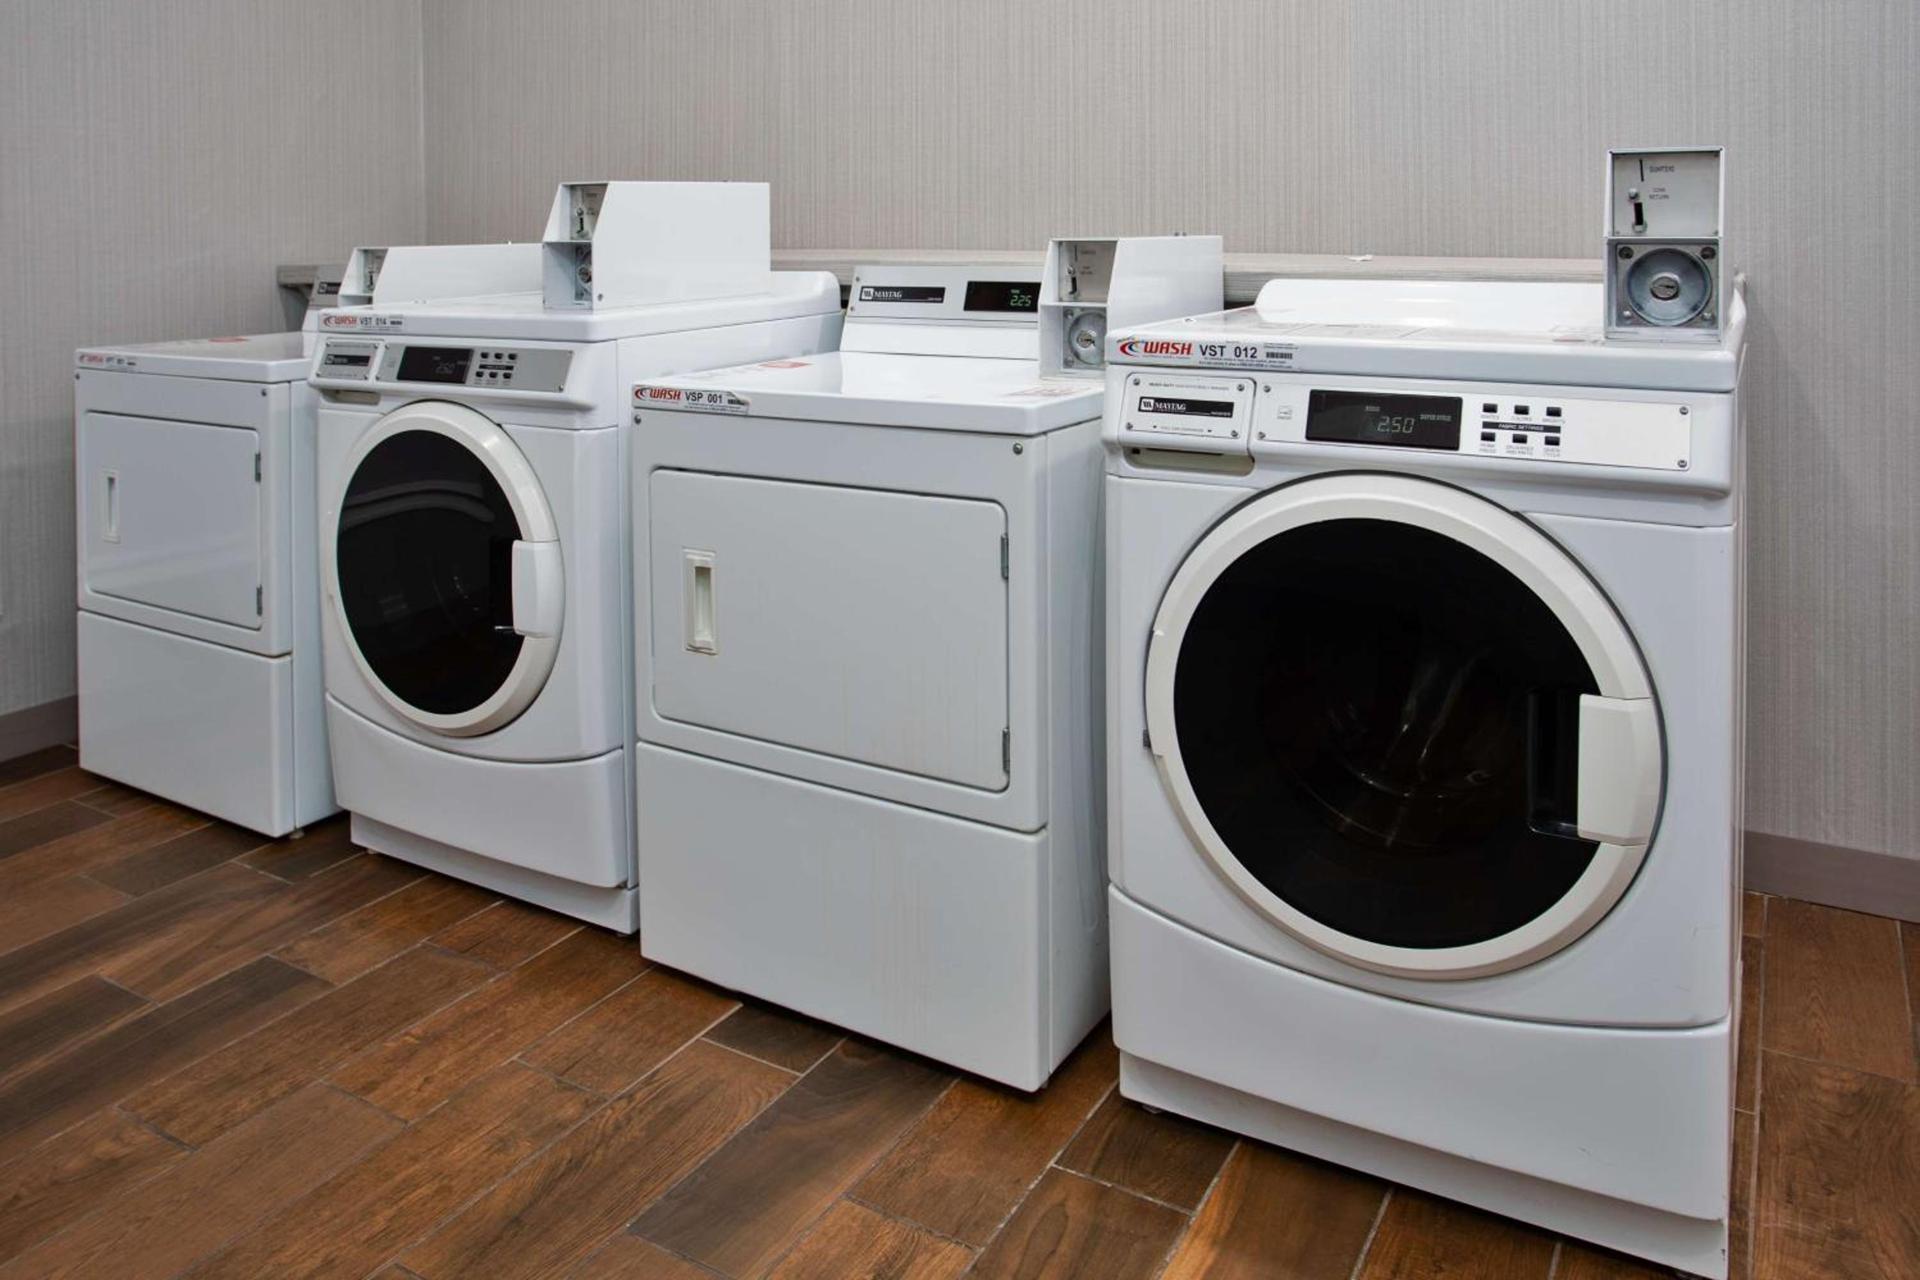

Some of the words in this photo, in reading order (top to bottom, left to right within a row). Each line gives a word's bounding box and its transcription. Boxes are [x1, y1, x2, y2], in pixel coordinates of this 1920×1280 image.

[873, 289, 903, 299] MAYTAG
[1142, 341, 1193, 356] WASH
[1199, 344, 1227, 358] VST
[1234, 346, 1258, 359] 012
[649, 388, 682, 400] WASH
[685, 391, 704, 402] VSP
[707, 393, 723, 404] 001
[1154, 401, 1187, 411] MAYTAG
[1376, 415, 1416, 433] 2.50
